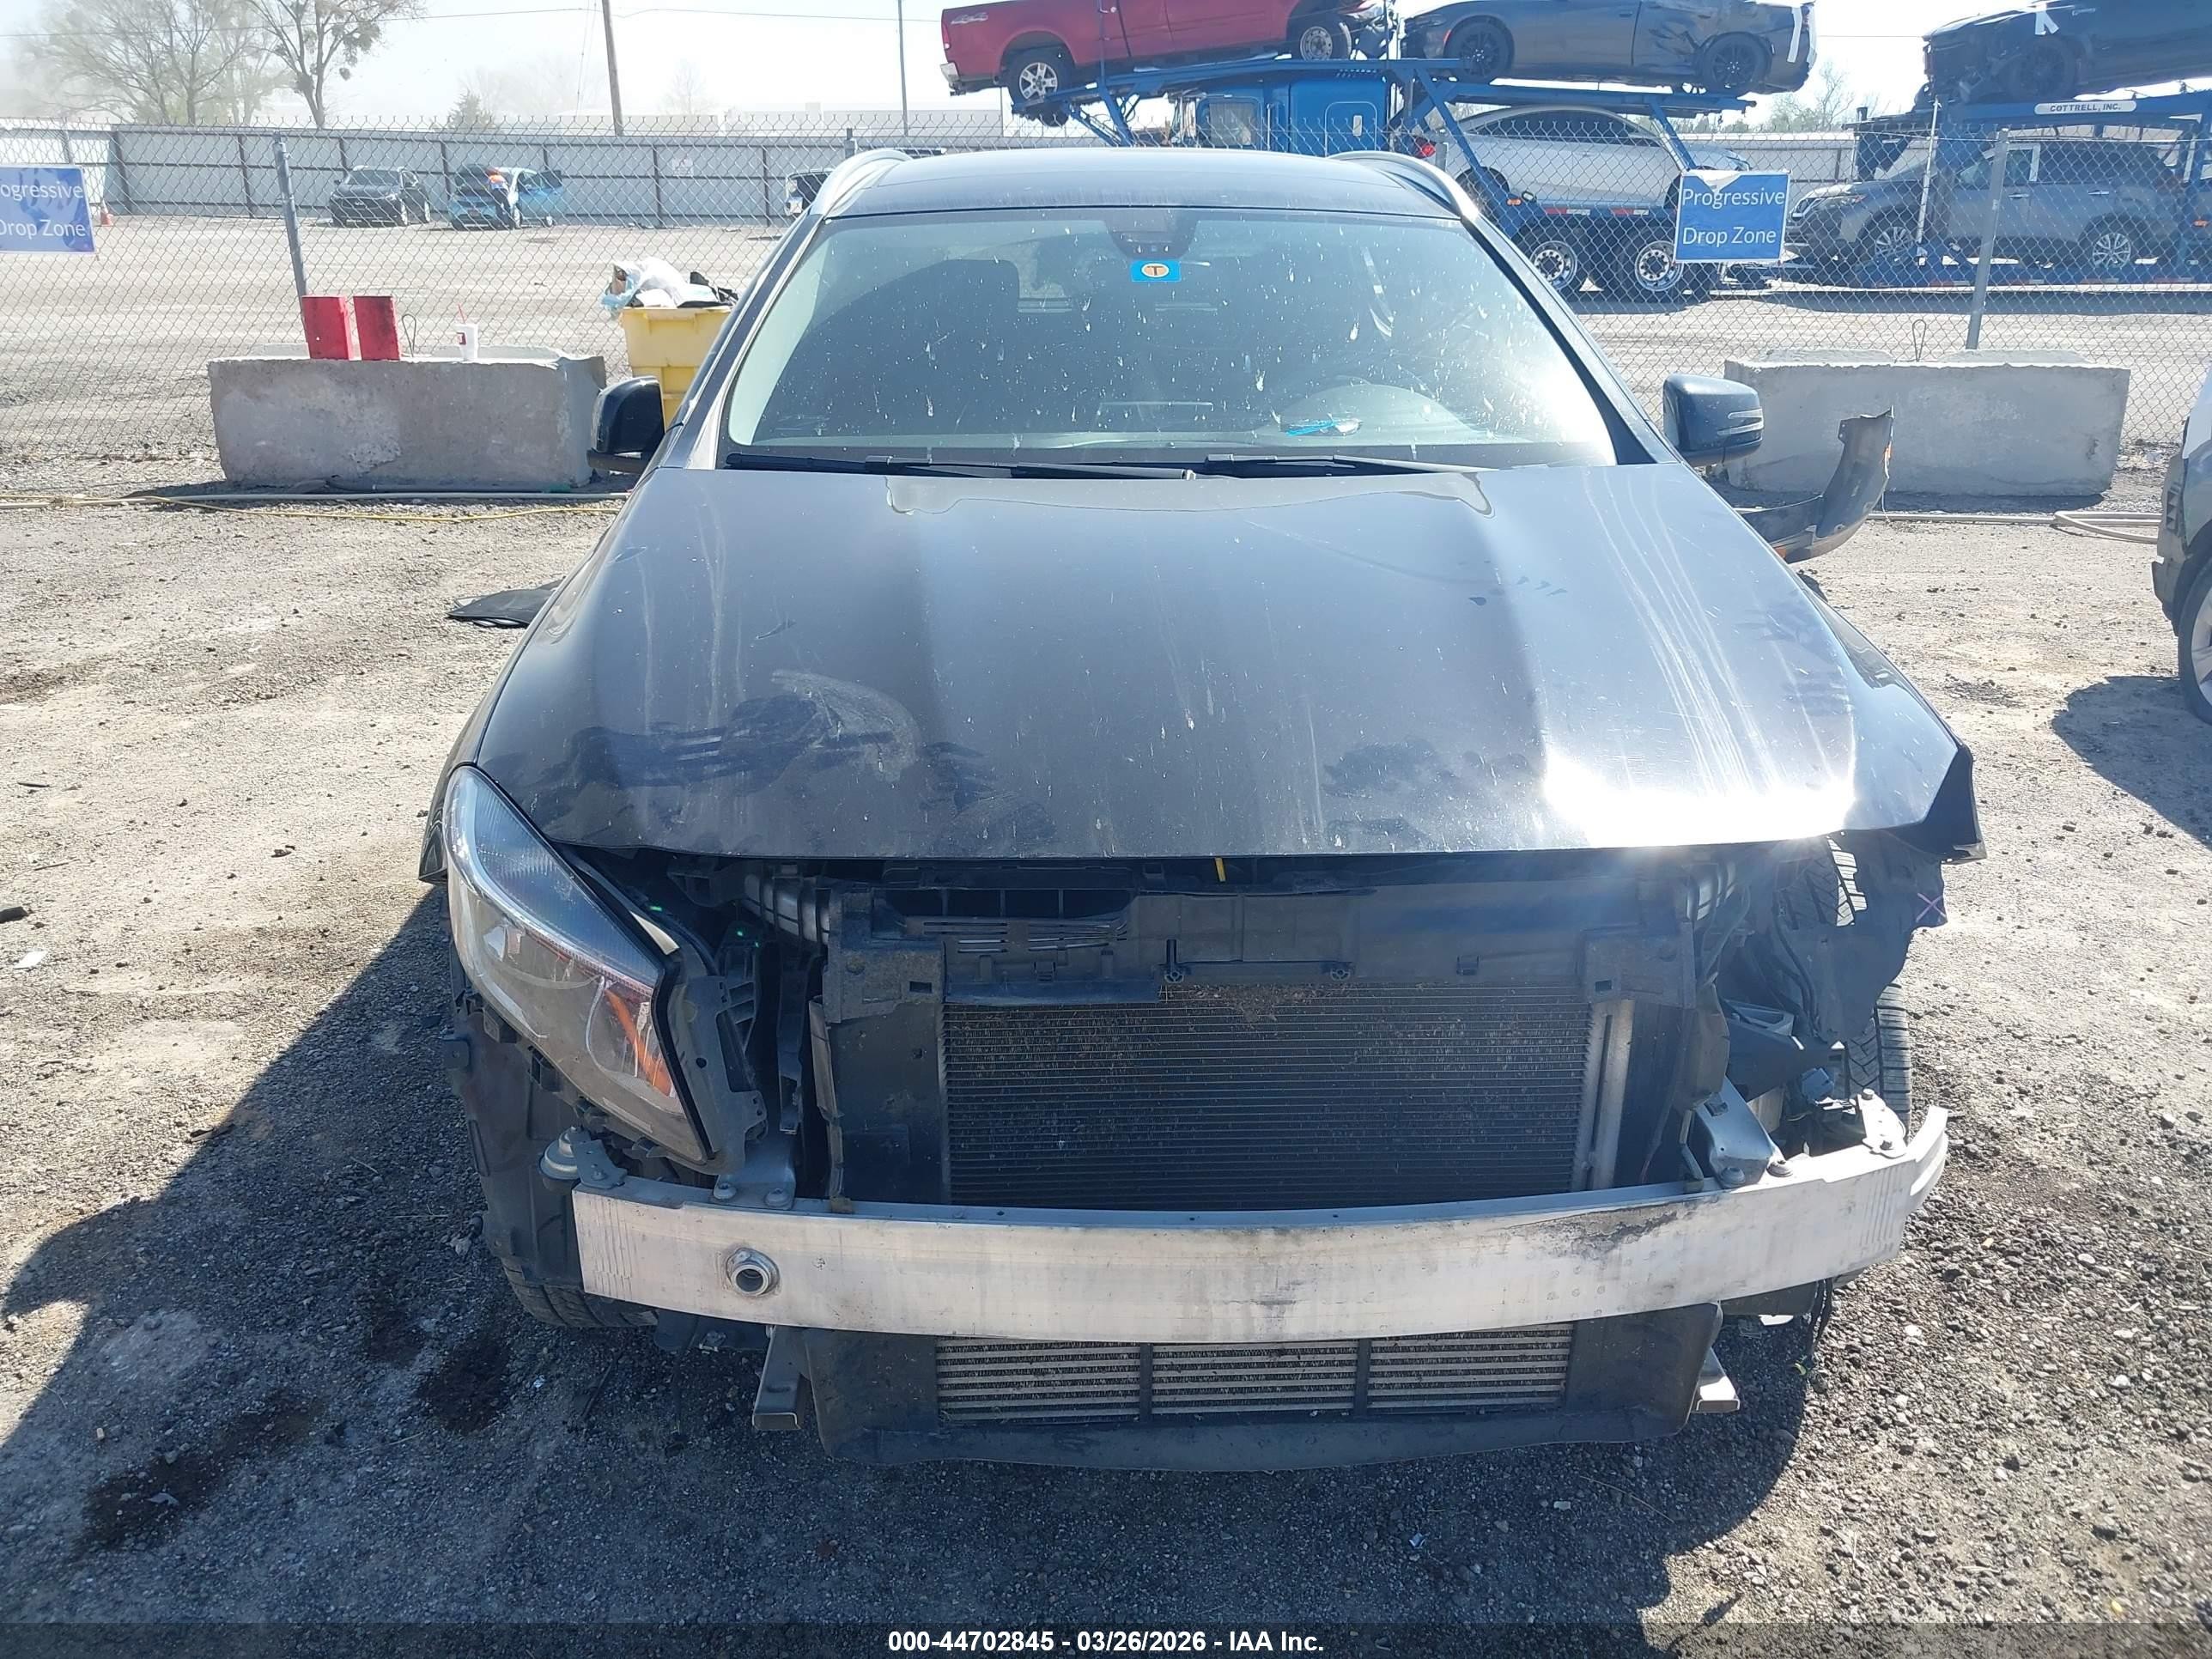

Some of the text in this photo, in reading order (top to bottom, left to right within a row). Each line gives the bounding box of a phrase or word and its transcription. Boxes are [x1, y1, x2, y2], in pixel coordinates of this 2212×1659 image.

[2050, 104, 2101, 112] COTTRELL,
[0, 181, 83, 202] ogressive
[1683, 187, 1785, 210] Progressive
[40, 219, 86, 237] Zone
[1683, 227, 1777, 247] Drop Zone
